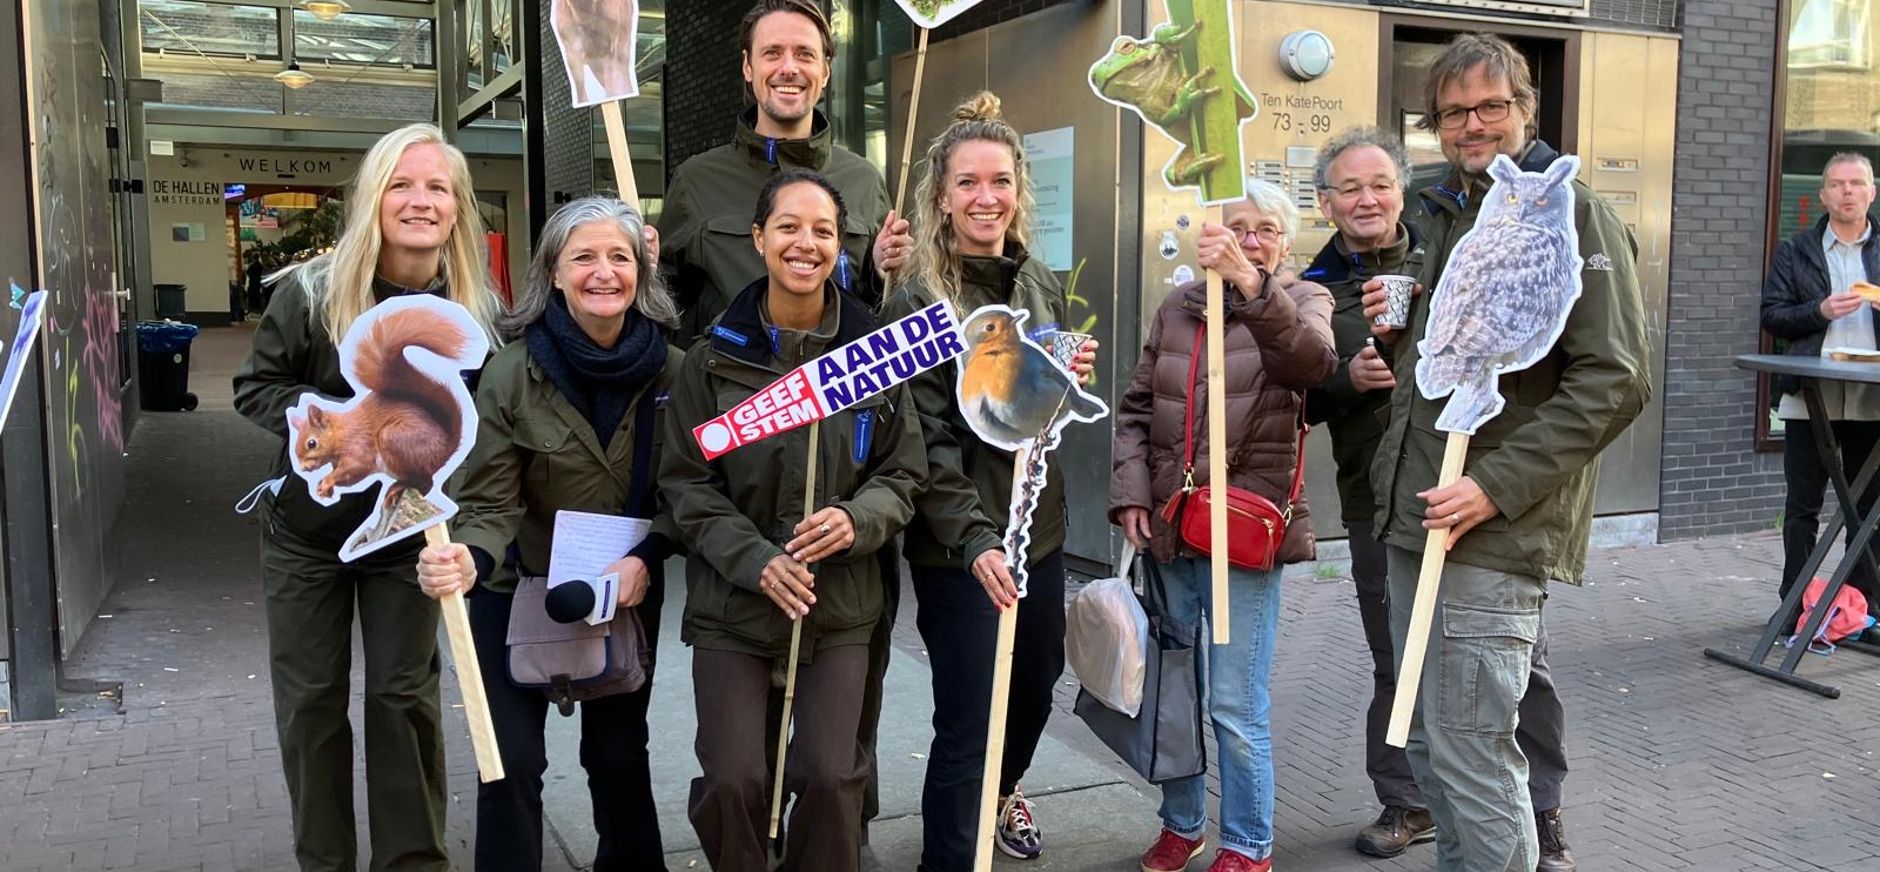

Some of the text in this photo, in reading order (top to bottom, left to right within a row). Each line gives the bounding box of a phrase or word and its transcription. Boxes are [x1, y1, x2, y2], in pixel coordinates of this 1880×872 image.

[1261, 93, 1281, 107] Ten
[1272, 112, 1291, 131] 73
[1310, 114, 1331, 132] 99
[239, 158, 331, 173] WELKOM
[153, 180, 220, 195] DE HALLEN
[154, 195, 220, 205] AMSTERDAM
[817, 302, 952, 387] AAN DE
[823, 331, 965, 412] NATUUR
[733, 371, 806, 426] GEEF
[739, 397, 820, 442] STEM
